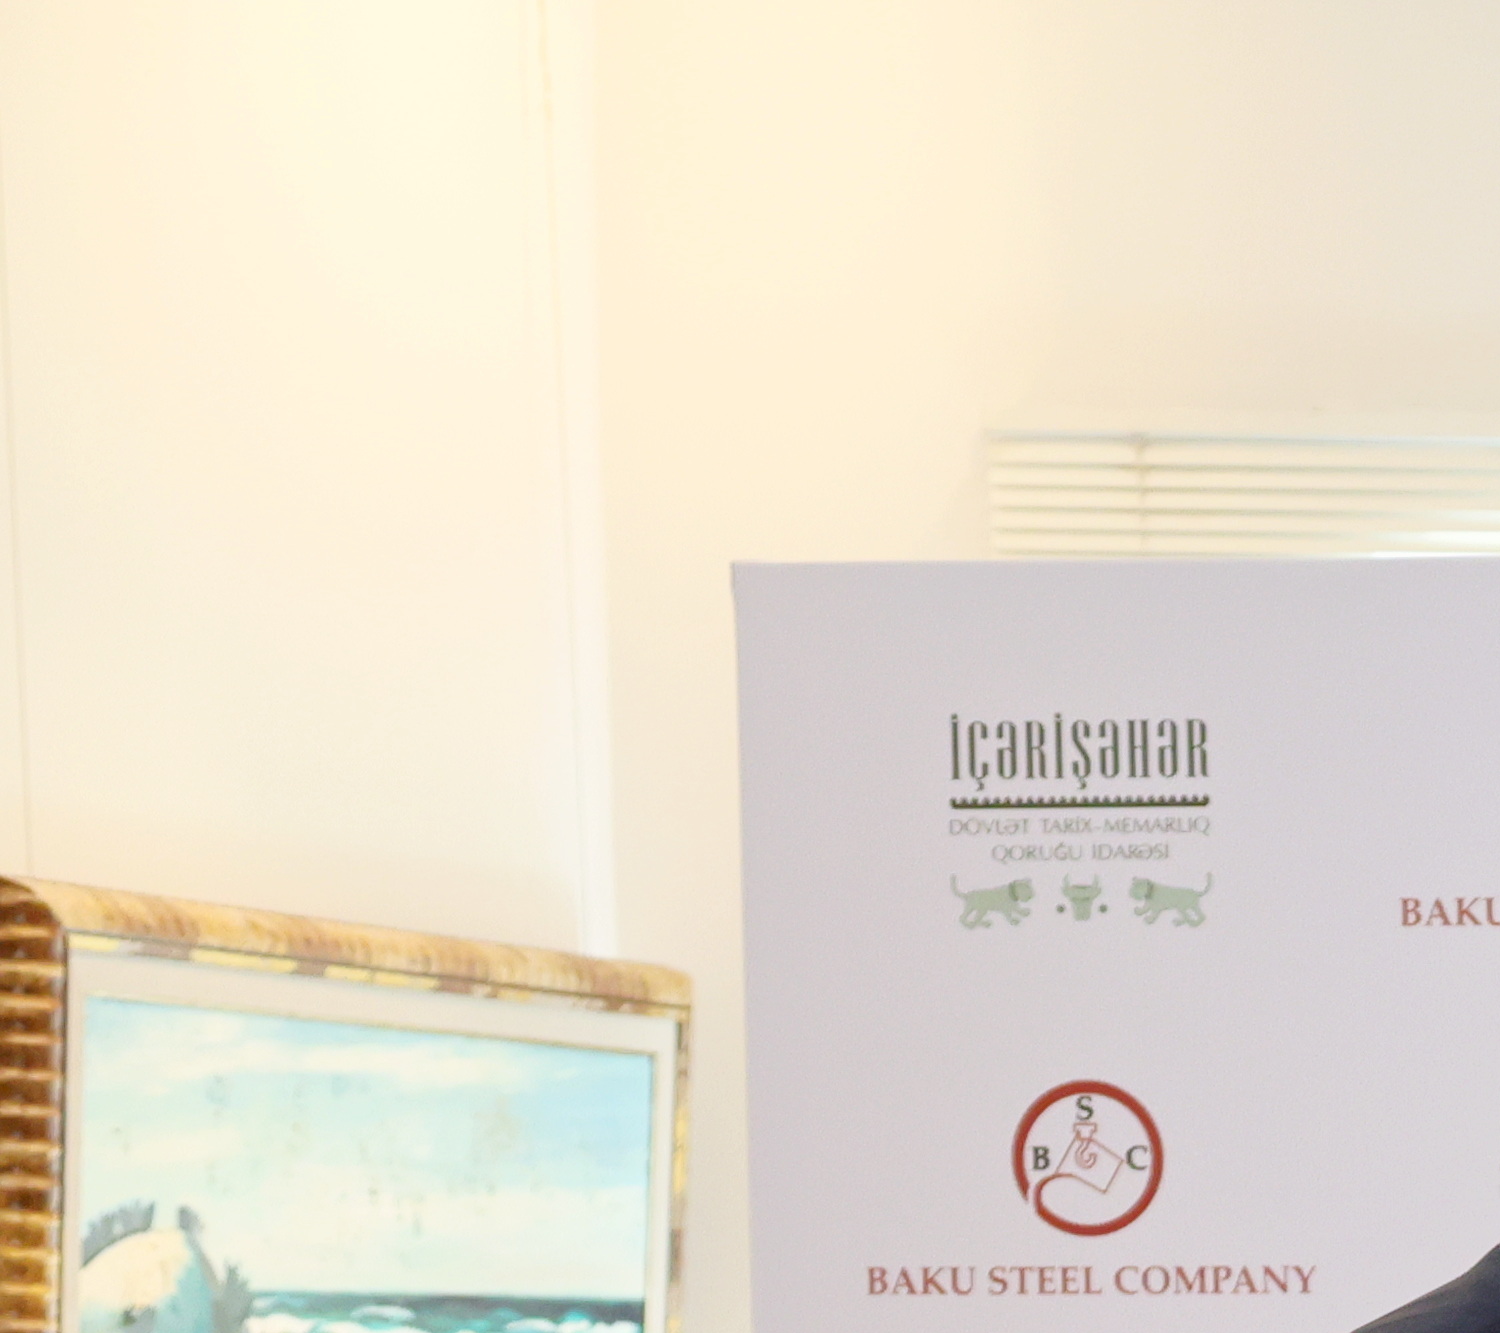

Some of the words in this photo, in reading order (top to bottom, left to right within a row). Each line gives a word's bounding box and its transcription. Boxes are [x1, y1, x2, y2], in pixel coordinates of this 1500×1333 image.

[948, 817, 1029, 836] DÖVLƏT
[991, 841, 1083, 865] QORUĞU
[1077, 1096, 1093, 1120] S
[1033, 1147, 1050, 1170] B
[1128, 1147, 1150, 1171] C
[867, 1266, 975, 1296] BAKU
[988, 1266, 1102, 1296] STEEL
[1113, 1265, 1316, 1296] COMPANY
